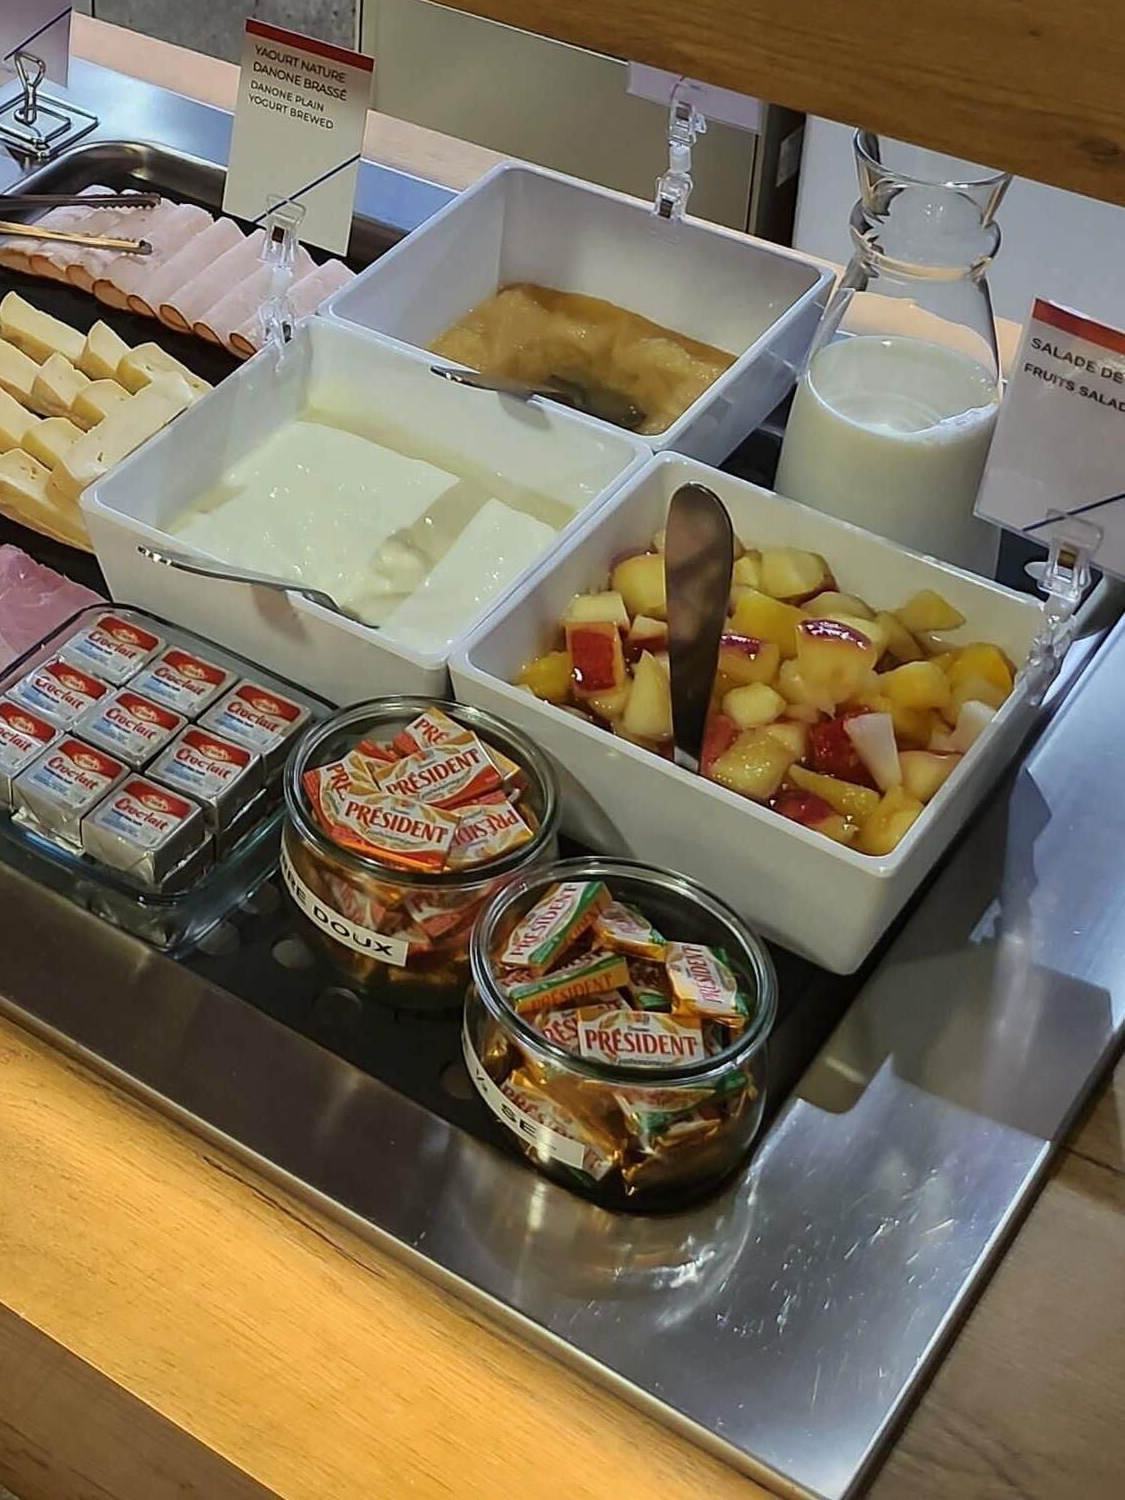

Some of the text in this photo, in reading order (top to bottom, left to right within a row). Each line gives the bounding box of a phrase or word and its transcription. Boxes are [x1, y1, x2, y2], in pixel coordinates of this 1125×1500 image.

[253, 61, 347, 101] DANONE BRASSÉ
[255, 45, 347, 83] YAOURT NATURE
[249, 94, 333, 129] YOGURT BREWED
[251, 80, 324, 112] DANONE PLAIN
[1024, 363, 1075, 392] FRUITS
[1031, 338, 1123, 384] SALADE DE
[385, 748, 480, 796] PRÉSIDENT
[345, 801, 449, 844] PRÉSIDENT
[313, 907, 393, 957] DOUX
[585, 1027, 696, 1059] PRÉSIDENT
